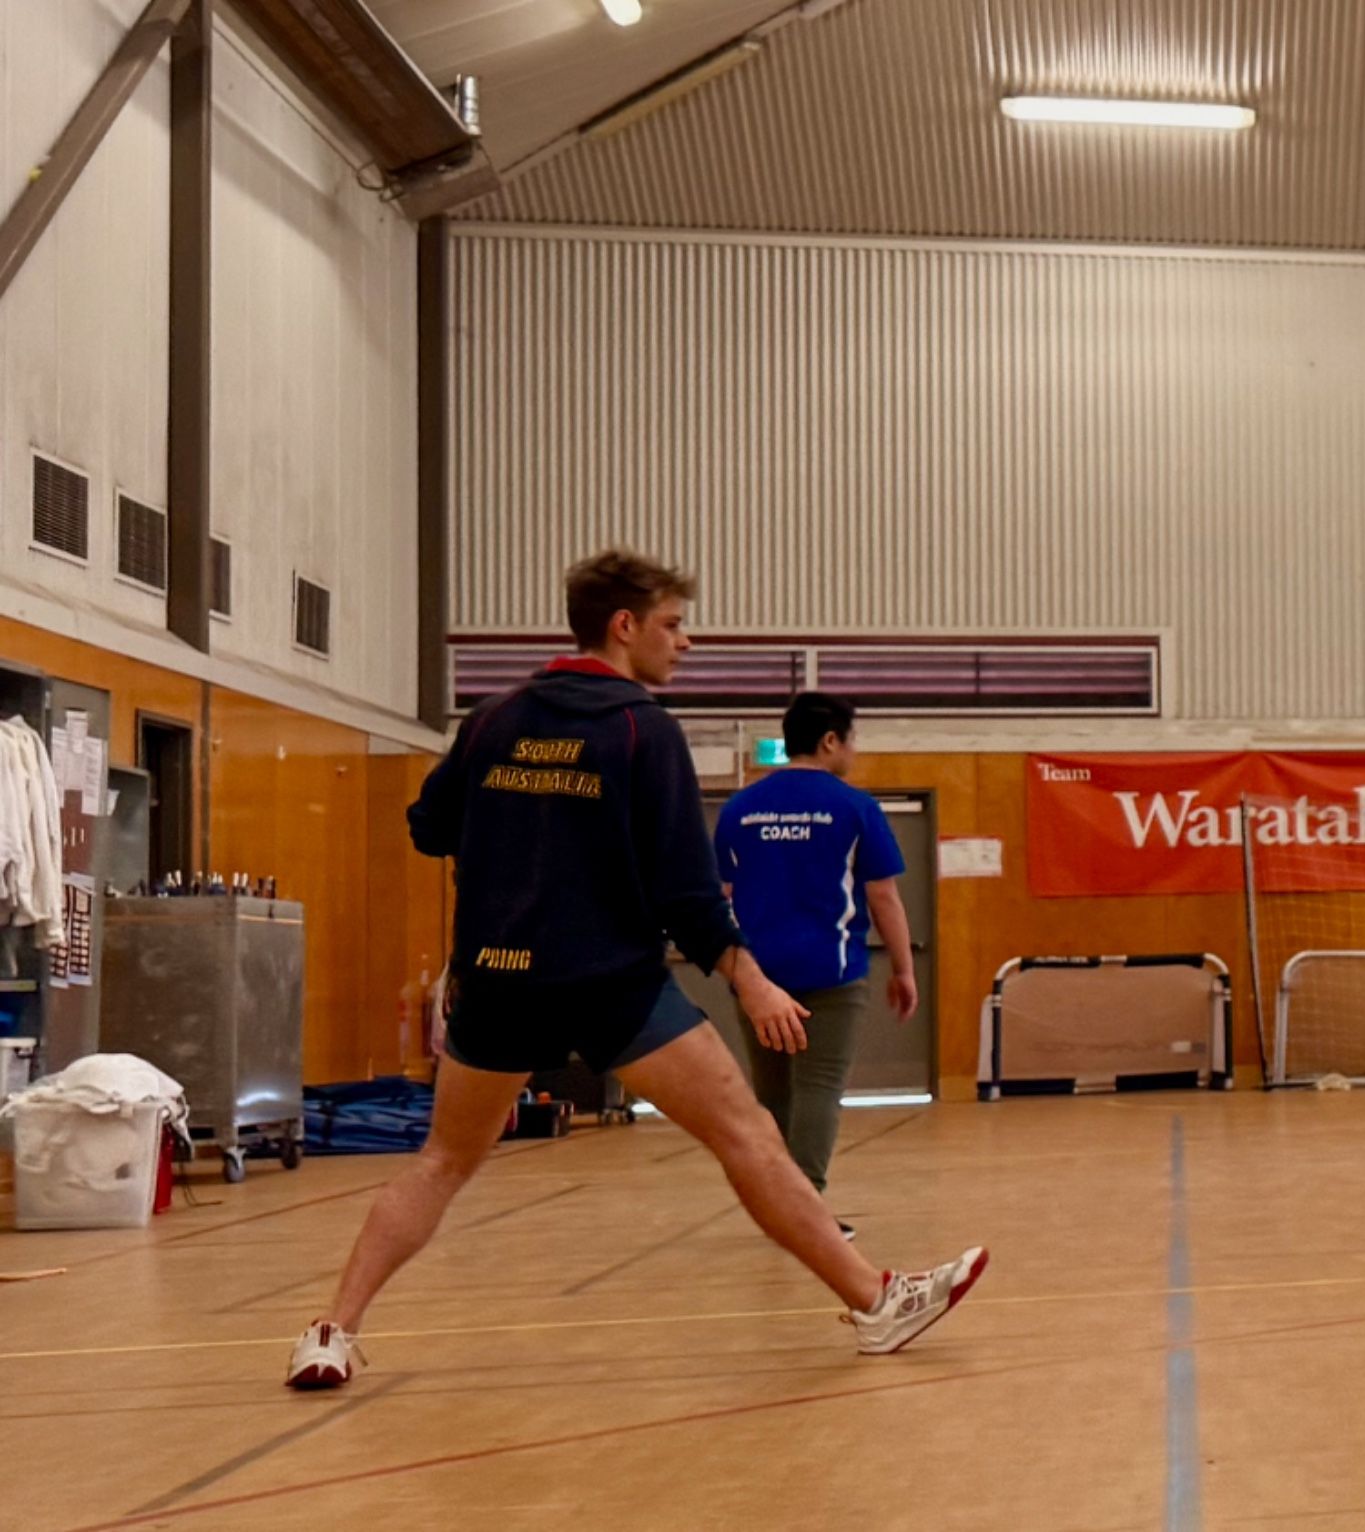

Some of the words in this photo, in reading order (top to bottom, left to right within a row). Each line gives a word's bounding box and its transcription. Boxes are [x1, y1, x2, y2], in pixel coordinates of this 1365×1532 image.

[512, 737, 585, 763] SOUTH
[1037, 763, 1091, 782] Team
[760, 826, 811, 841] COACH
